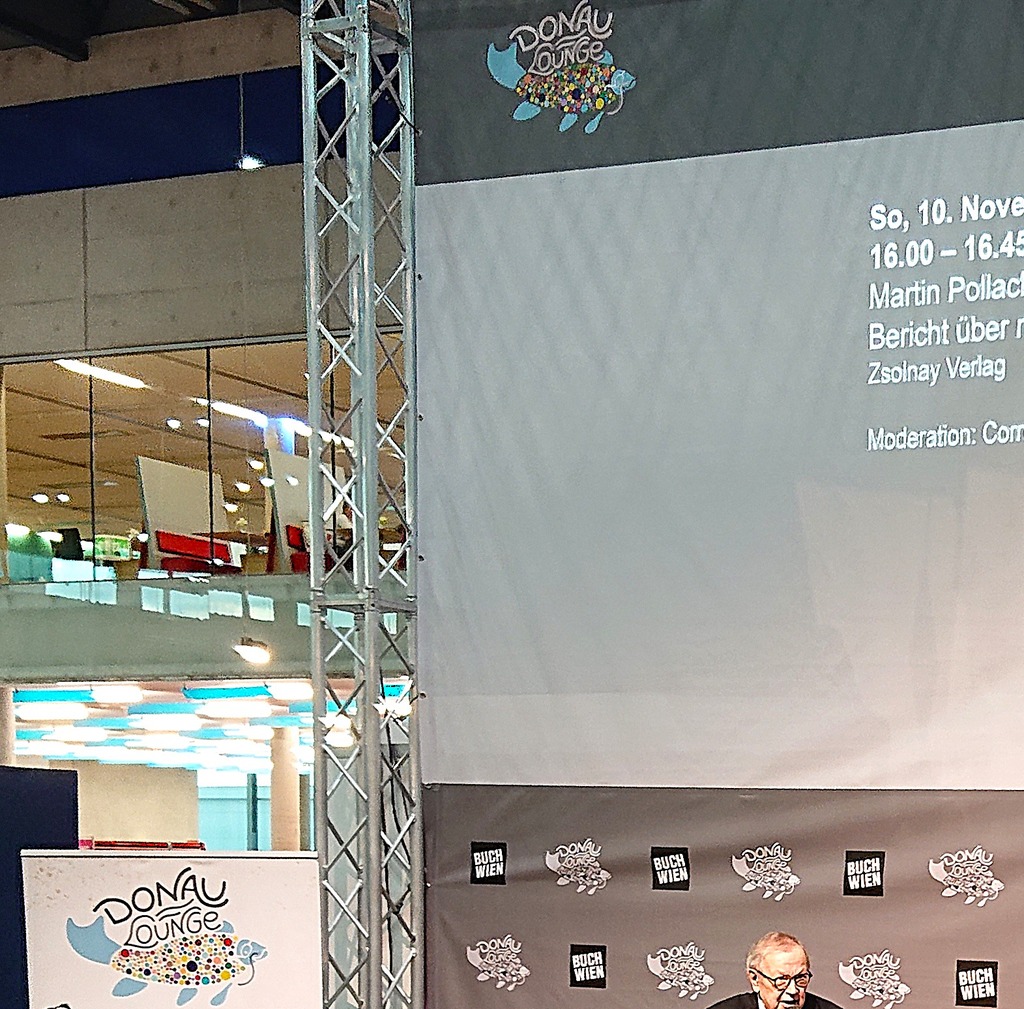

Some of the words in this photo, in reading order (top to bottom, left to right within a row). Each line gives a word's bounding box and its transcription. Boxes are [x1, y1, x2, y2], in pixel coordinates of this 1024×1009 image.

[509, 0, 613, 52] DONAU
[528, 36, 604, 76] LOUNGE
[869, 203, 910, 233] So,
[918, 198, 953, 226] 10.
[870, 238, 935, 270] 16.00
[868, 279, 940, 310] Martin
[868, 318, 950, 351] Bericht
[955, 315, 1010, 344] über
[867, 360, 941, 387] Zsolnay
[945, 354, 1007, 382] Verlag
[867, 424, 977, 451] Moderation:
[556, 838, 601, 857] DONAU
[742, 842, 792, 861] DONAU
[941, 845, 994, 866] DONAU
[473, 849, 503, 866] BUCH
[653, 854, 685, 870] BUCH
[847, 857, 881, 875] BUCH
[475, 863, 503, 879] WIEN
[656, 868, 688, 885] WIEN
[848, 872, 882, 890] WIEN
[93, 867, 229, 925] DONAU
[124, 909, 222, 948] LOUNGE
[476, 934, 522, 953] DONAU
[656, 942, 705, 961] DONAU
[572, 951, 603, 968] BUCH
[849, 949, 901, 970] DONAU
[574, 966, 605, 982] WIEN
[958, 967, 993, 985] BUCH
[961, 982, 995, 1001] WIEN
